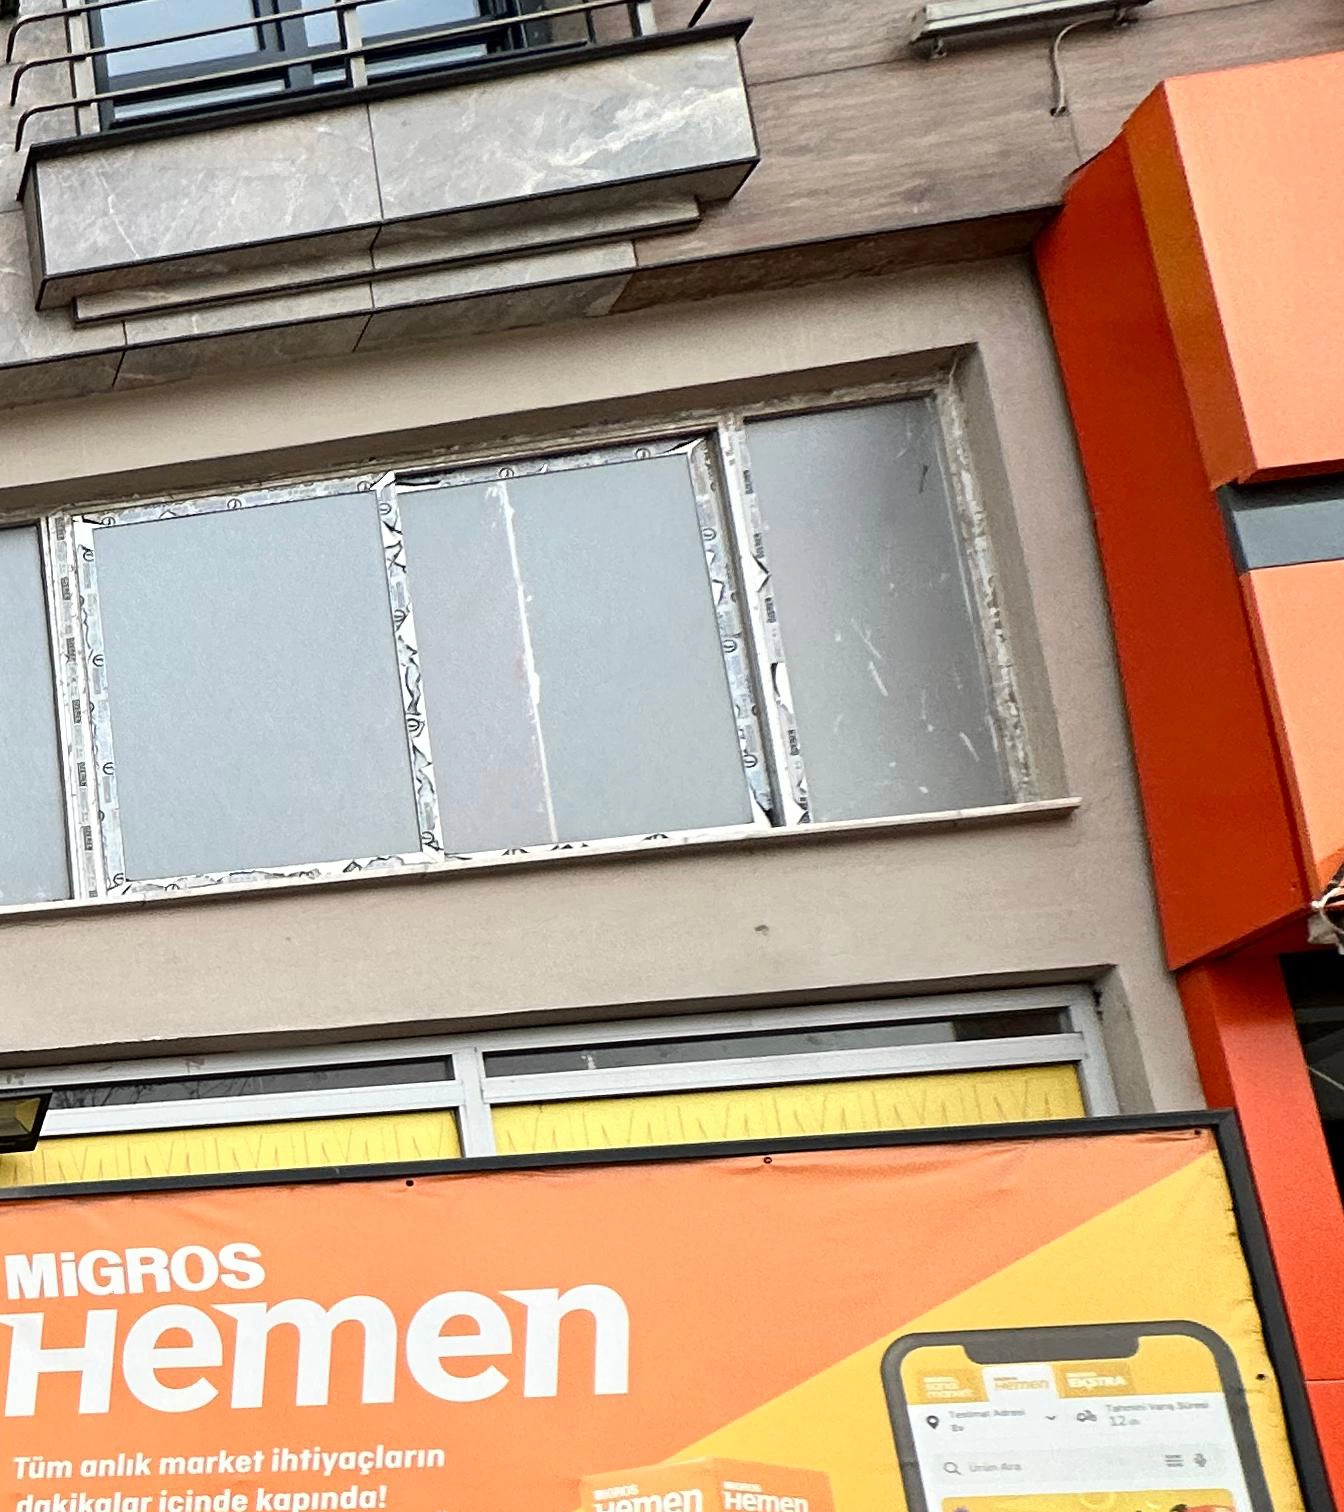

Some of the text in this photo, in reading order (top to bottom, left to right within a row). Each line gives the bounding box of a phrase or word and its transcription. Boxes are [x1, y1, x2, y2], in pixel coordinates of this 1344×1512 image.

[12, 1444, 445, 1481] Tüm anlık market ihtiyaçların
